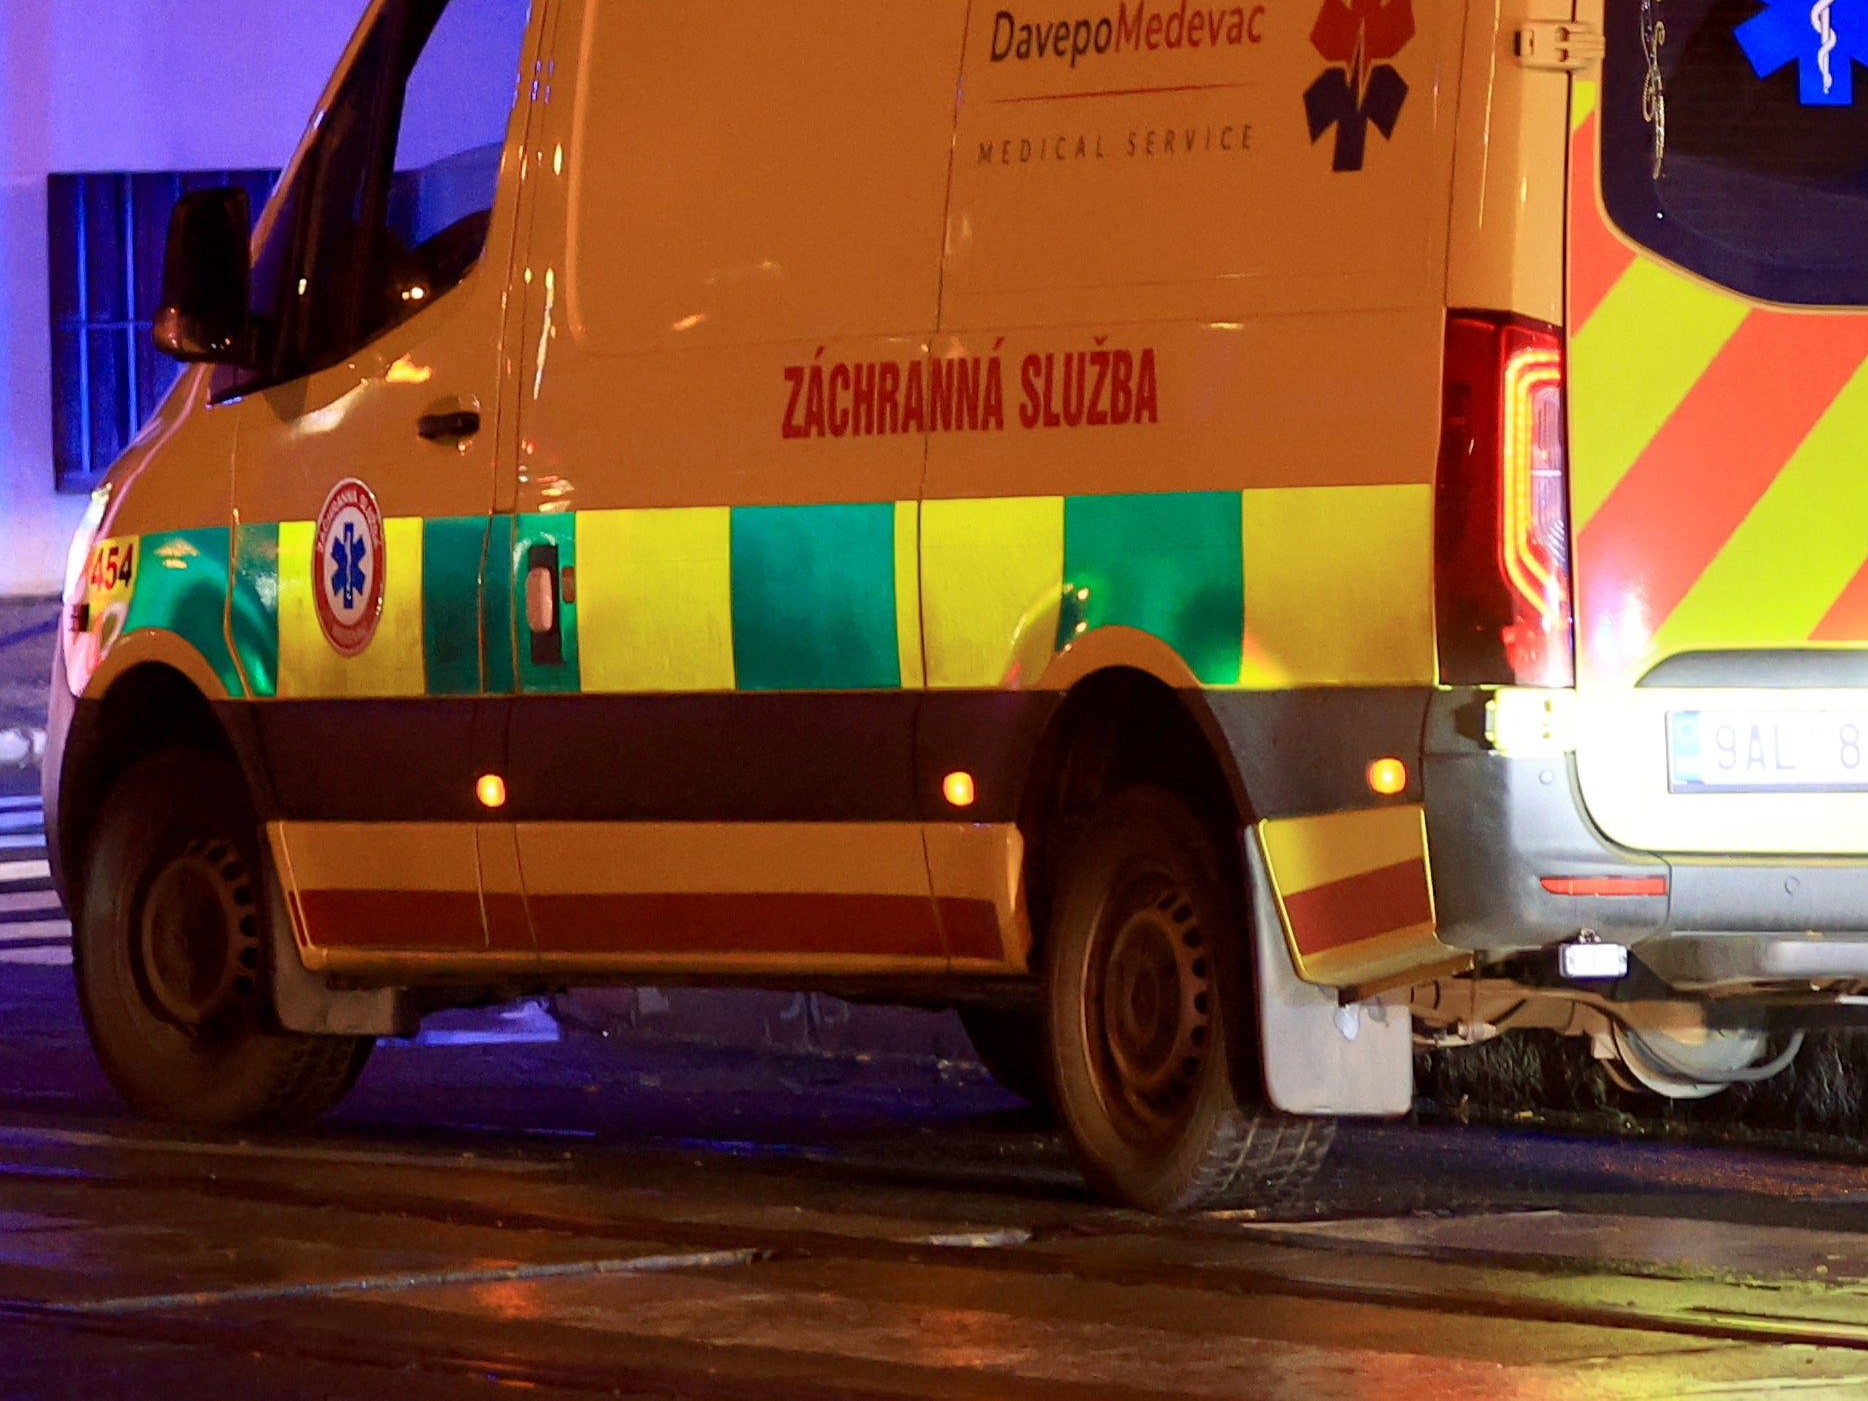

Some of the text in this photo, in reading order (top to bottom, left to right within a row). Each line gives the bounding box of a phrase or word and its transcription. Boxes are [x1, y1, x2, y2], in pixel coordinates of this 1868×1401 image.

[977, 124, 1252, 165] MEDICAL SERVICE
[782, 335, 1159, 439] ZÁCHRANNÁ SLUŽBA
[91, 543, 133, 591] 454
[1716, 724, 1797, 771] 9AL
